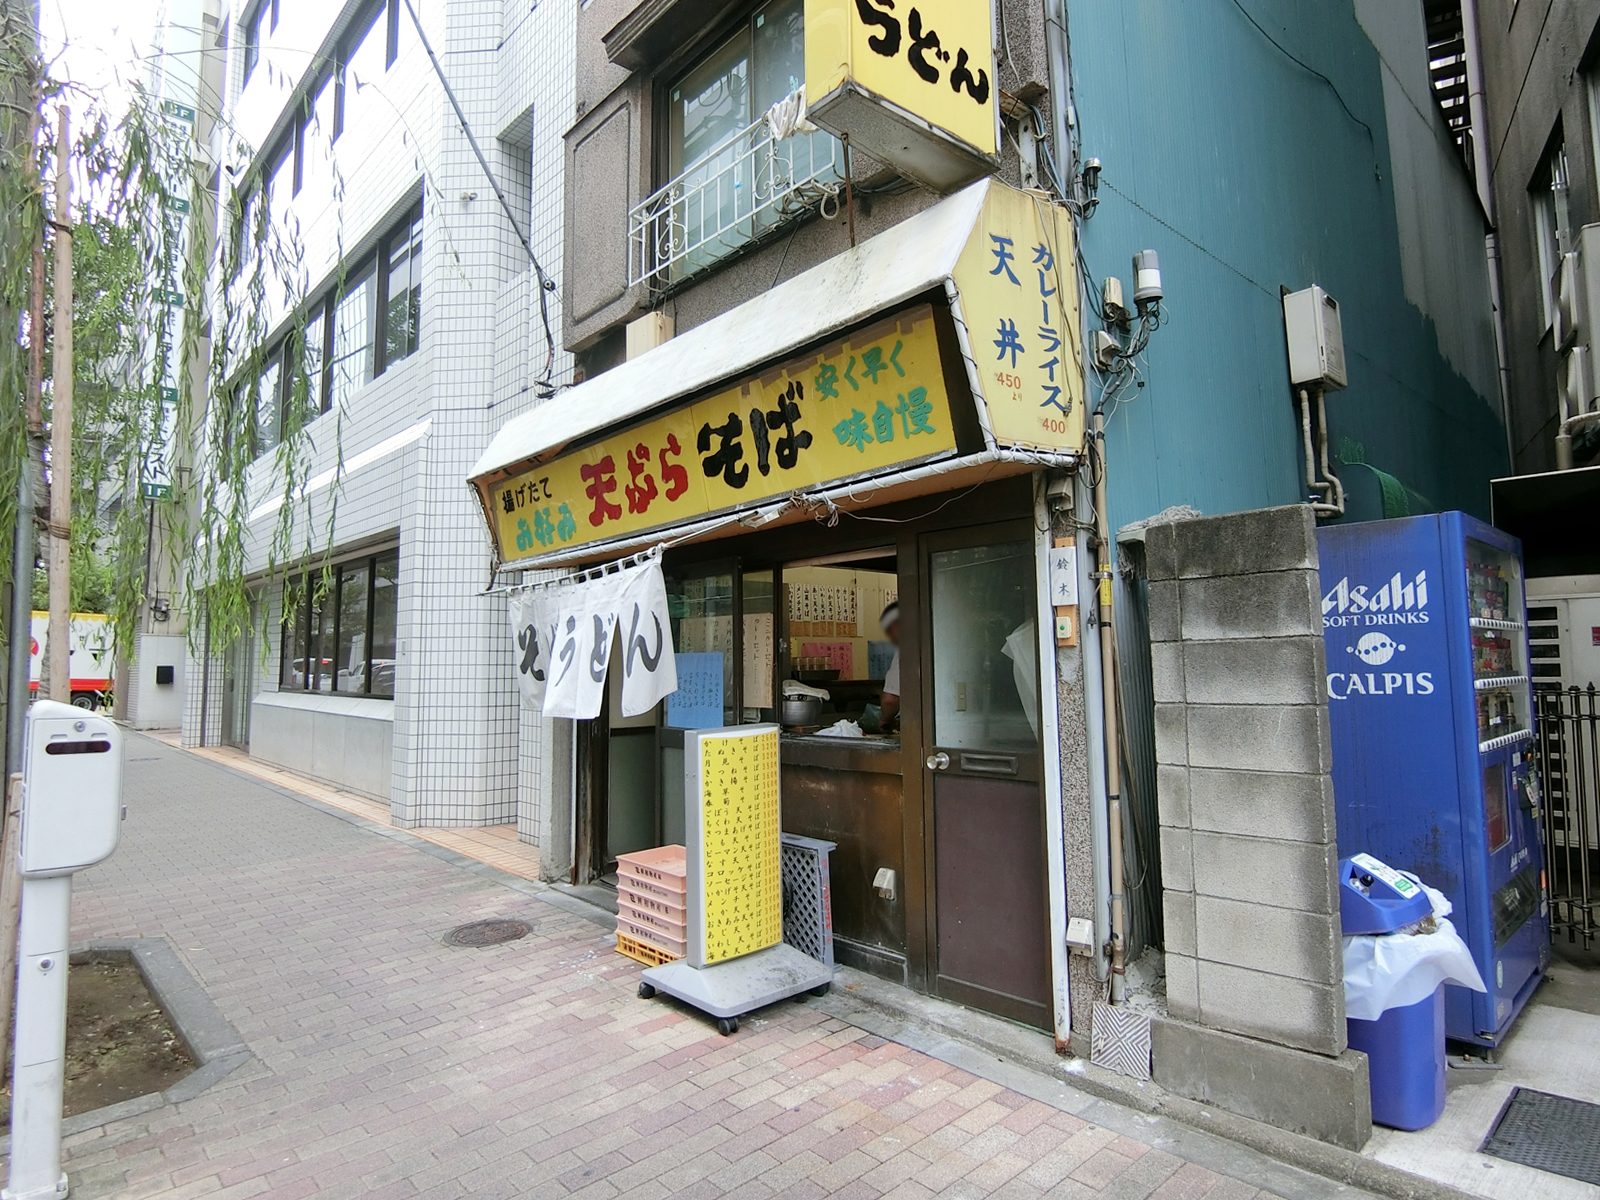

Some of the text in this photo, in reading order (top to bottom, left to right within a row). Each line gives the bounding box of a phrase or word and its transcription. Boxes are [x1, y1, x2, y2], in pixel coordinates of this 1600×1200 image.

[855, 0, 990, 105] うどん
[1031, 242, 1066, 413] カレーライス
[814, 341, 906, 400] 安く早く
[996, 372, 1022, 389] 450
[833, 386, 936, 453] 味自慢
[1042, 417, 1066, 434] 400
[580, 381, 813, 527] 天ぷら そば
[502, 477, 553, 514] 揚げたて
[1056, 557, 1070, 597] 鈴木
[1321, 570, 1428, 615] Asahi
[1322, 611, 1430, 628] SOFT DRINKS
[1326, 672, 1435, 700] CALPIS
